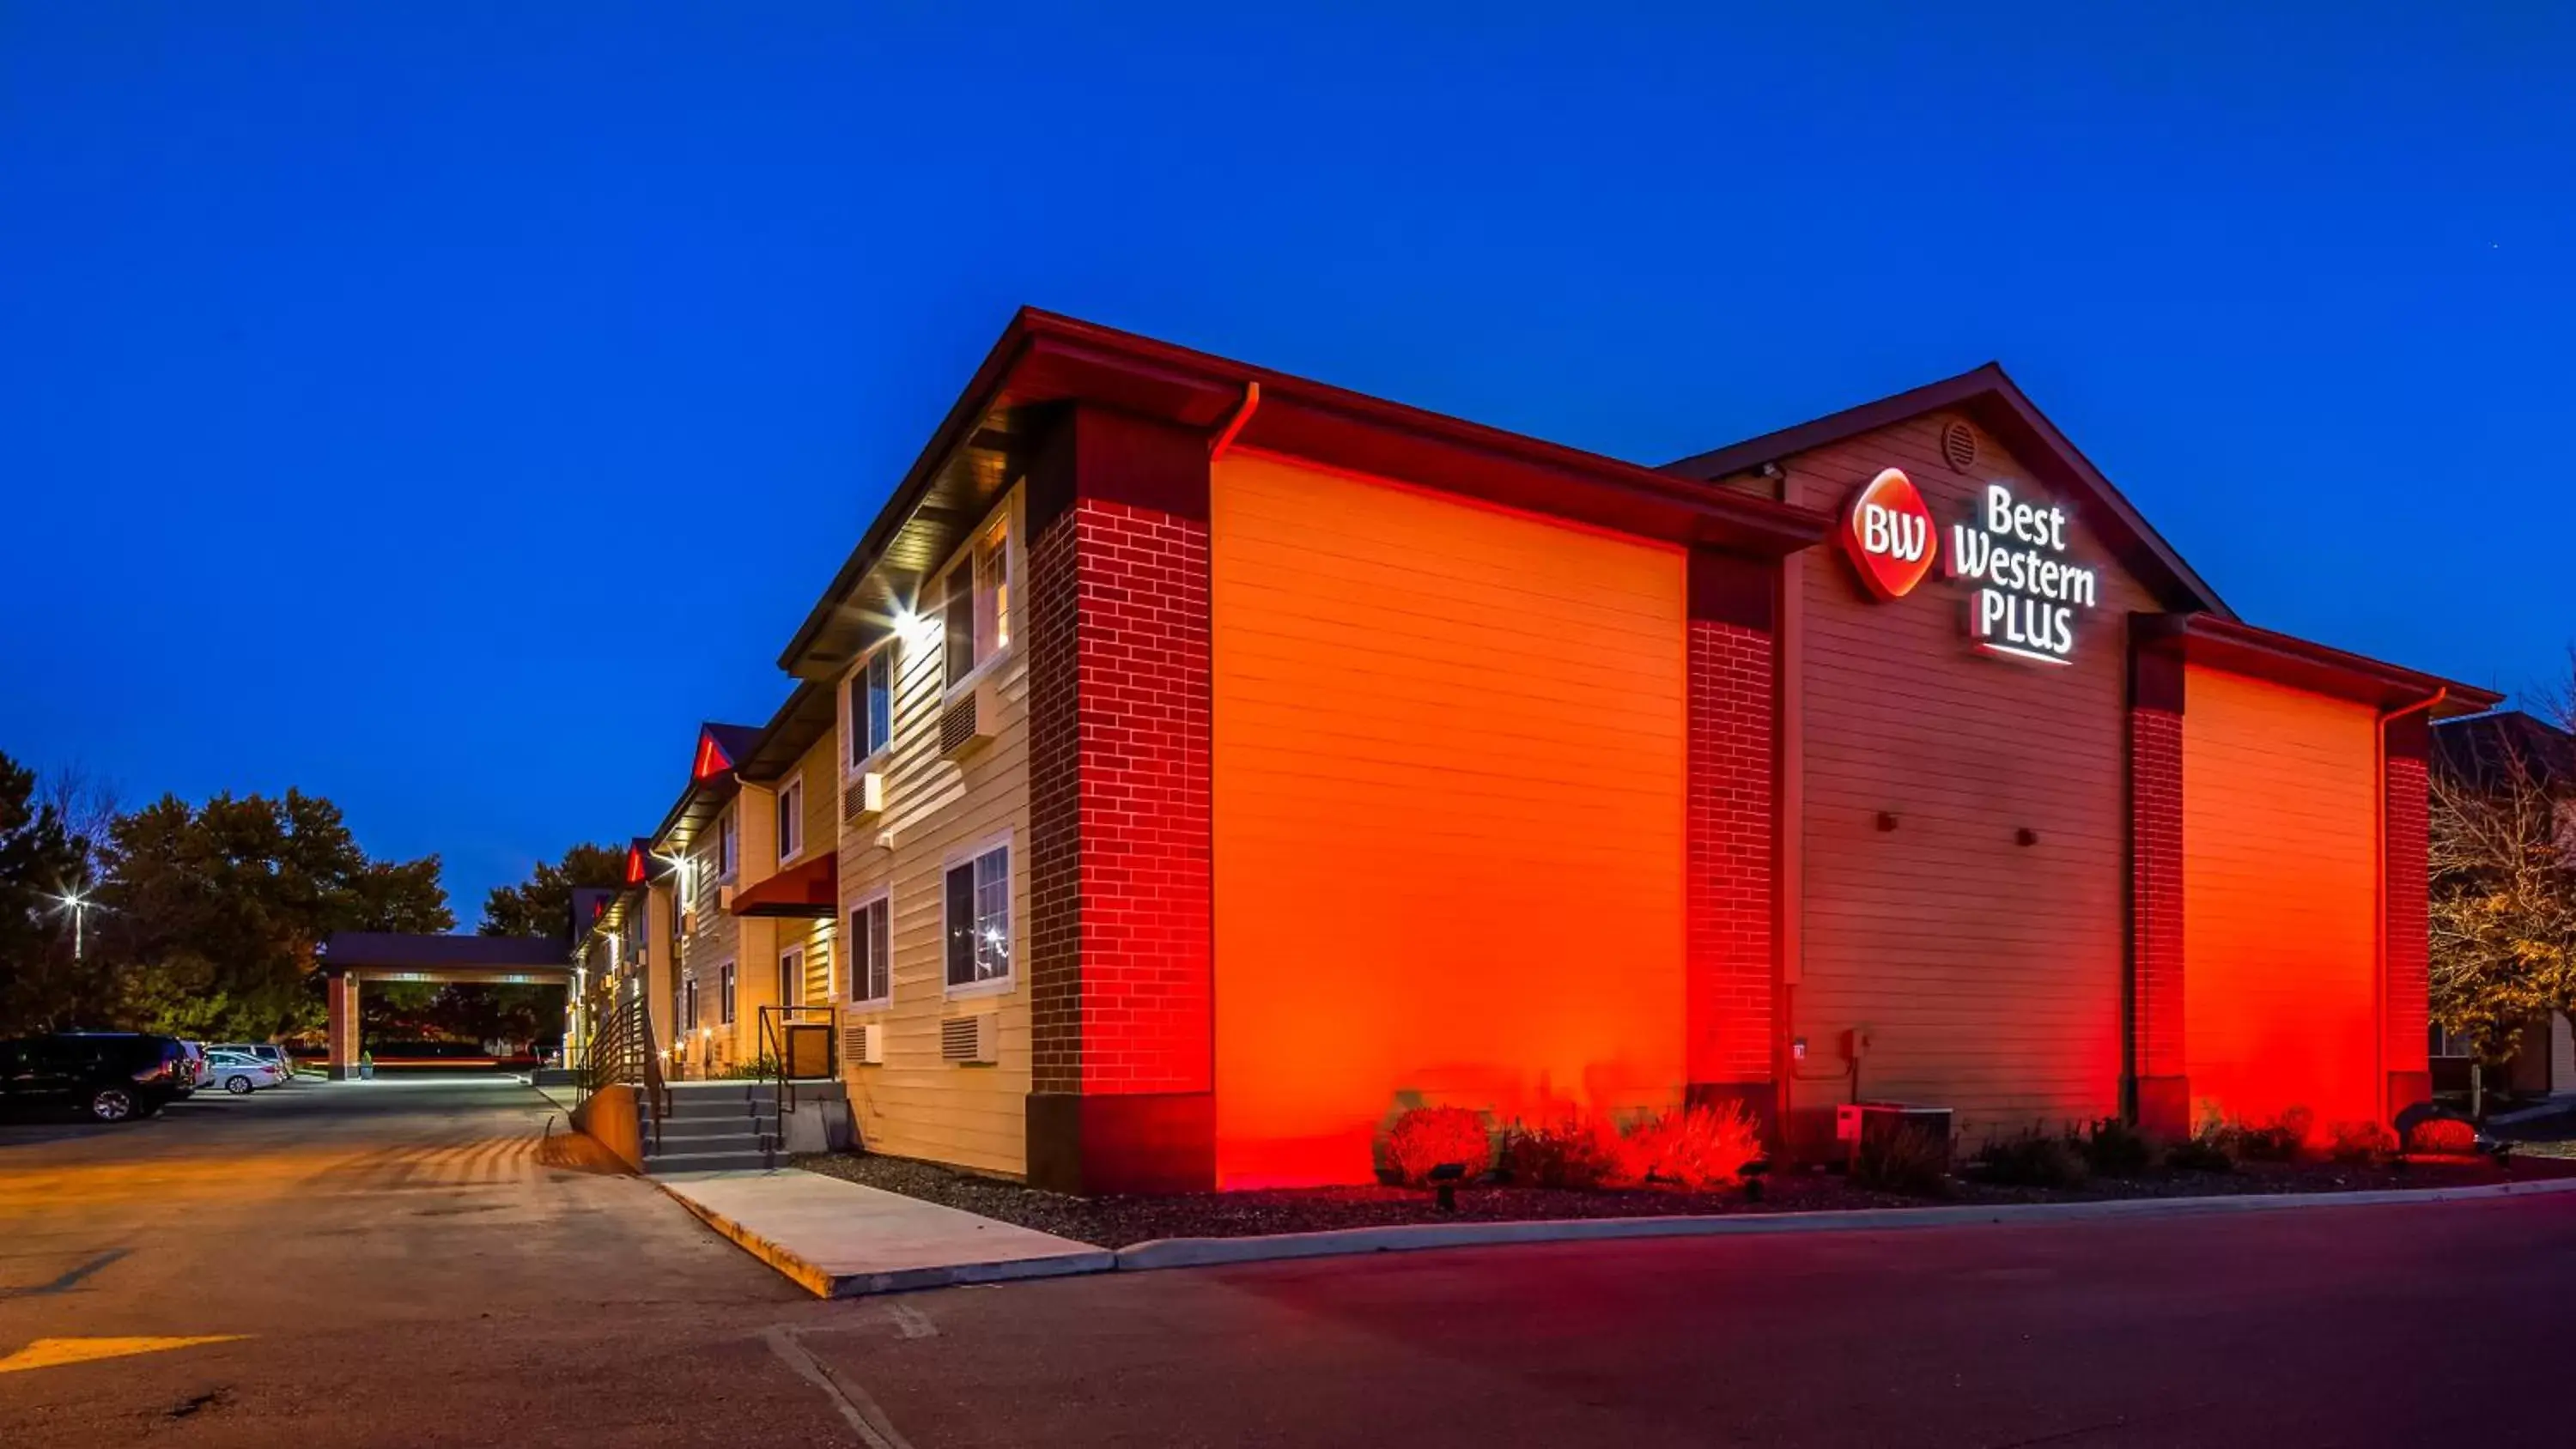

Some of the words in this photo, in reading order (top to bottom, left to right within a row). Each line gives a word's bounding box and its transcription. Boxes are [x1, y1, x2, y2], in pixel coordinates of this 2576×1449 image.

[1864, 504, 1926, 562] BW
[1987, 484, 2066, 550] Best
[1953, 524, 2095, 607] Western
[1981, 588, 2072, 654] PLUS
